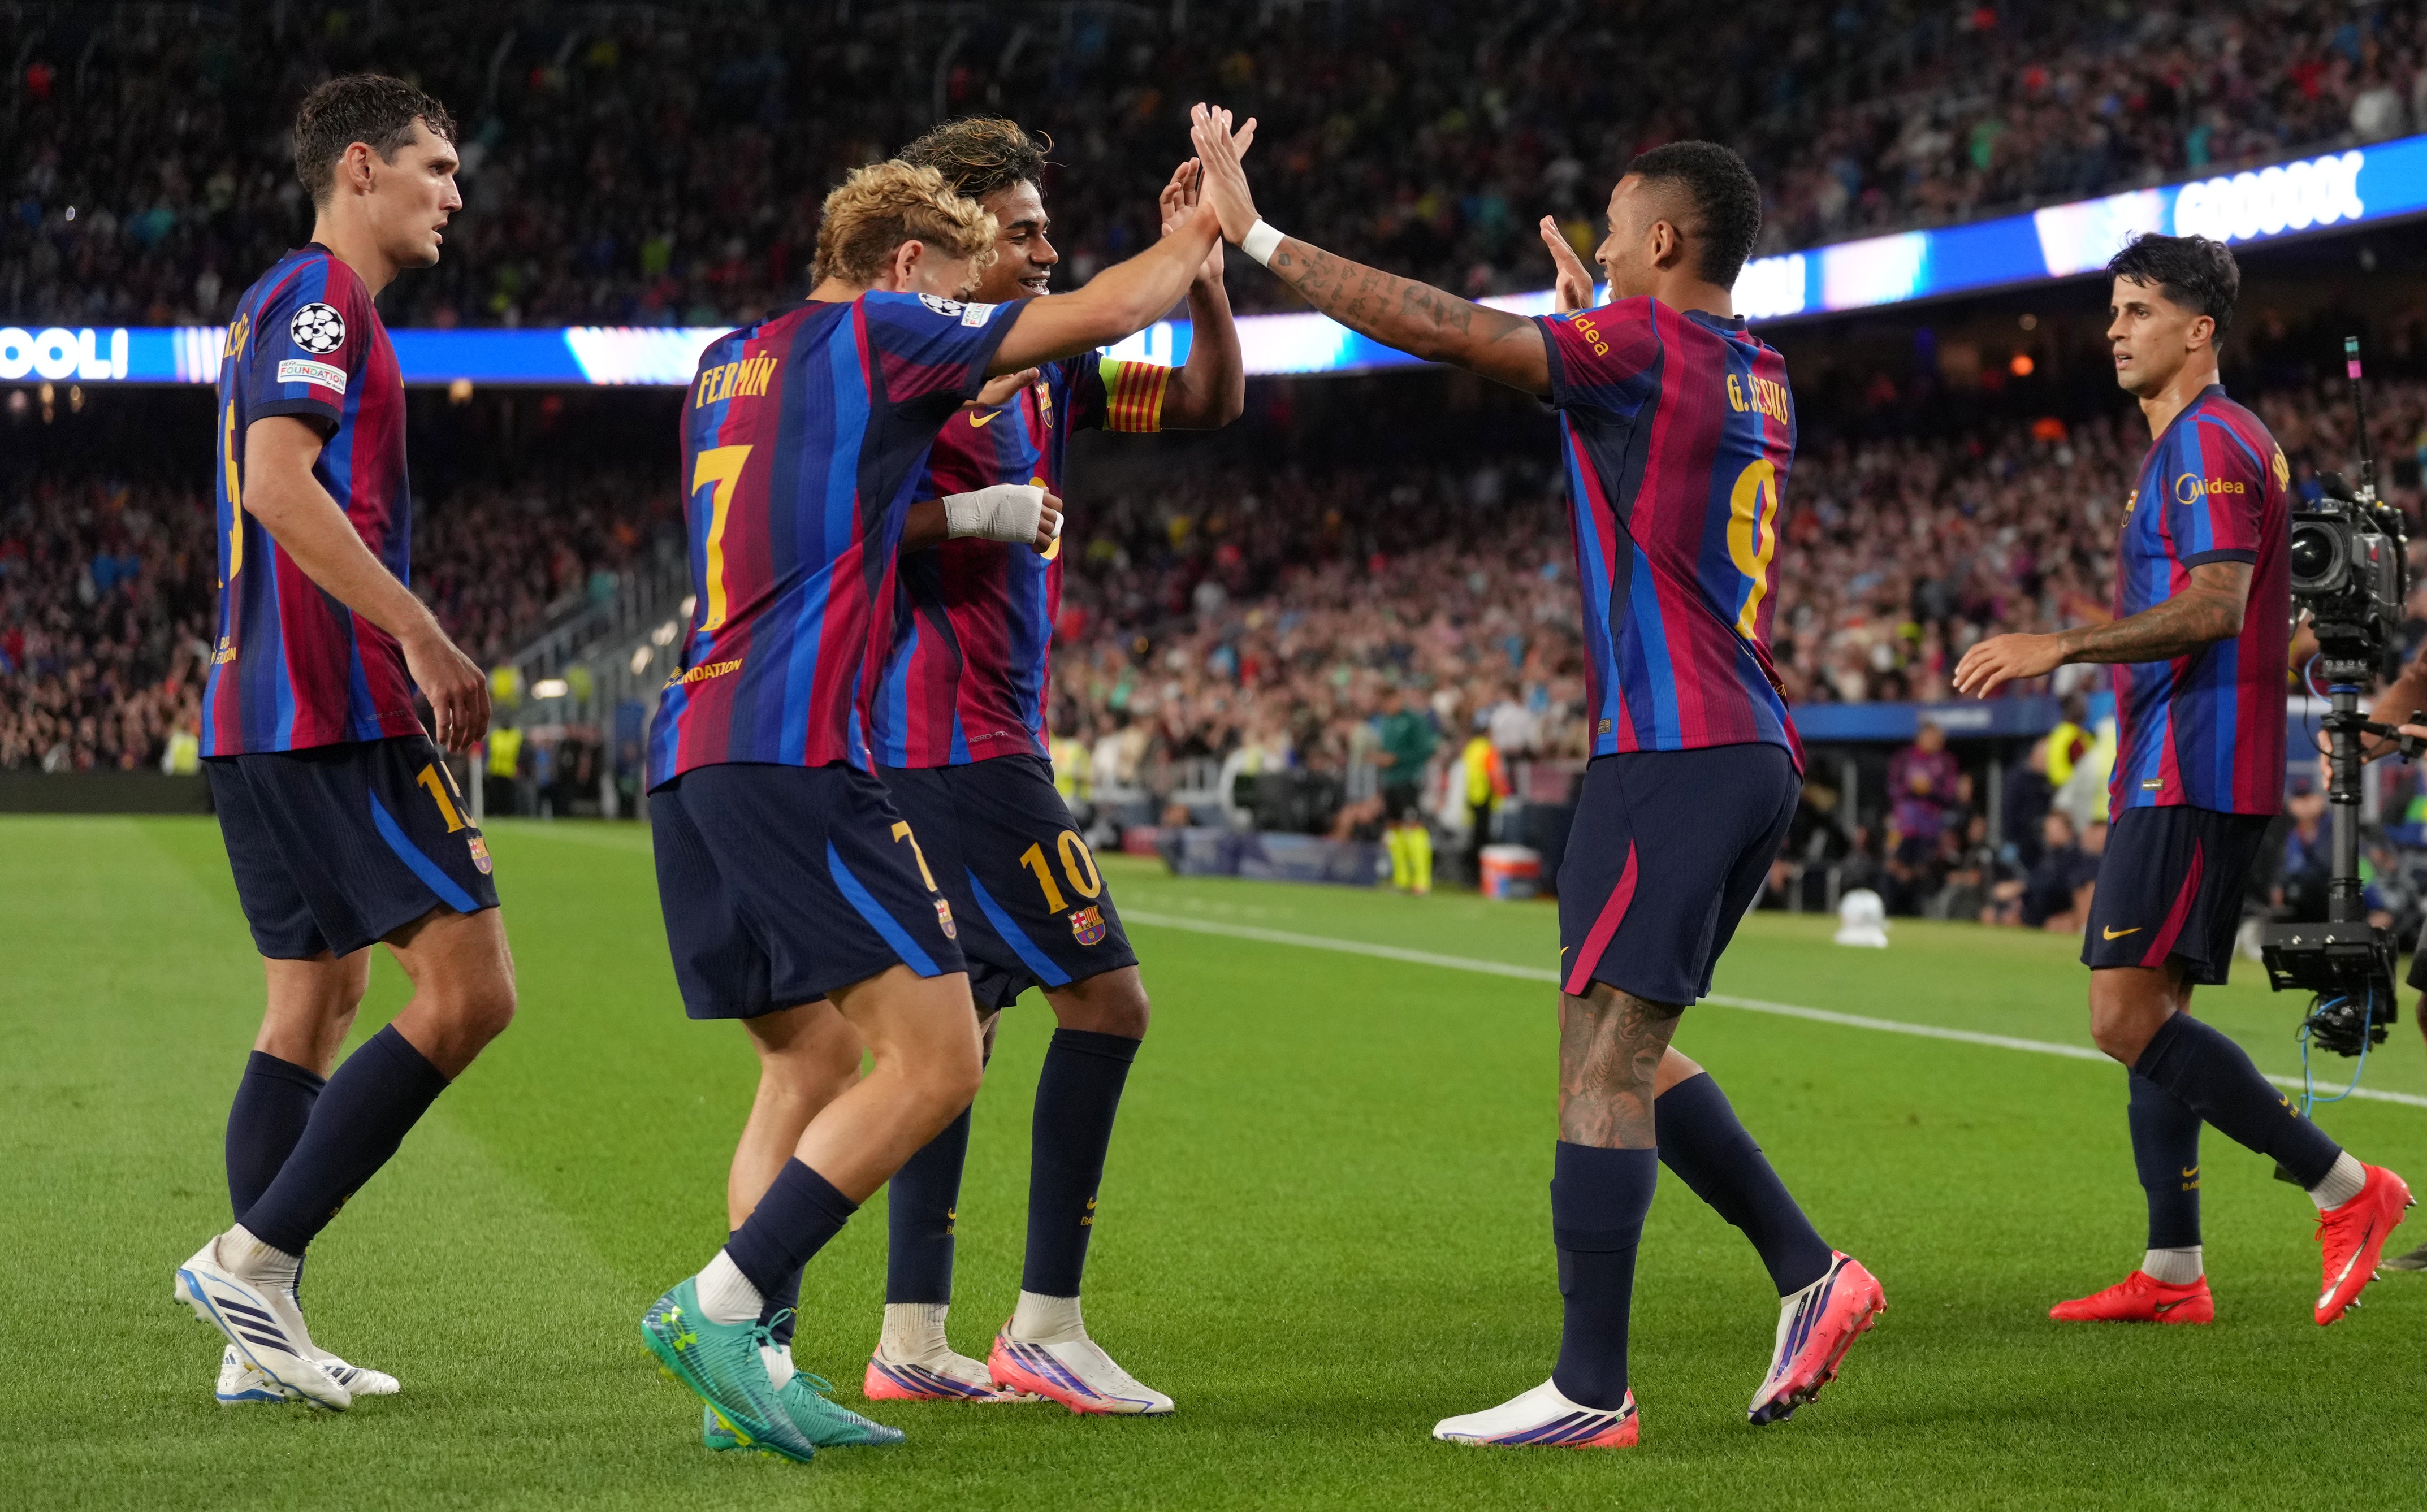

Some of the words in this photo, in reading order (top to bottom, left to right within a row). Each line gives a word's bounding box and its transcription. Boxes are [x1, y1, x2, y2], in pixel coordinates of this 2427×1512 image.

[311, 318, 326, 338] 5
[696, 350, 778, 409] FERMÍN
[2181, 475, 2244, 502] Midea
[691, 444, 754, 631] 7
[1727, 459, 1777, 639] 9
[891, 820, 938, 892] 7
[1019, 830, 1101, 915] 10
